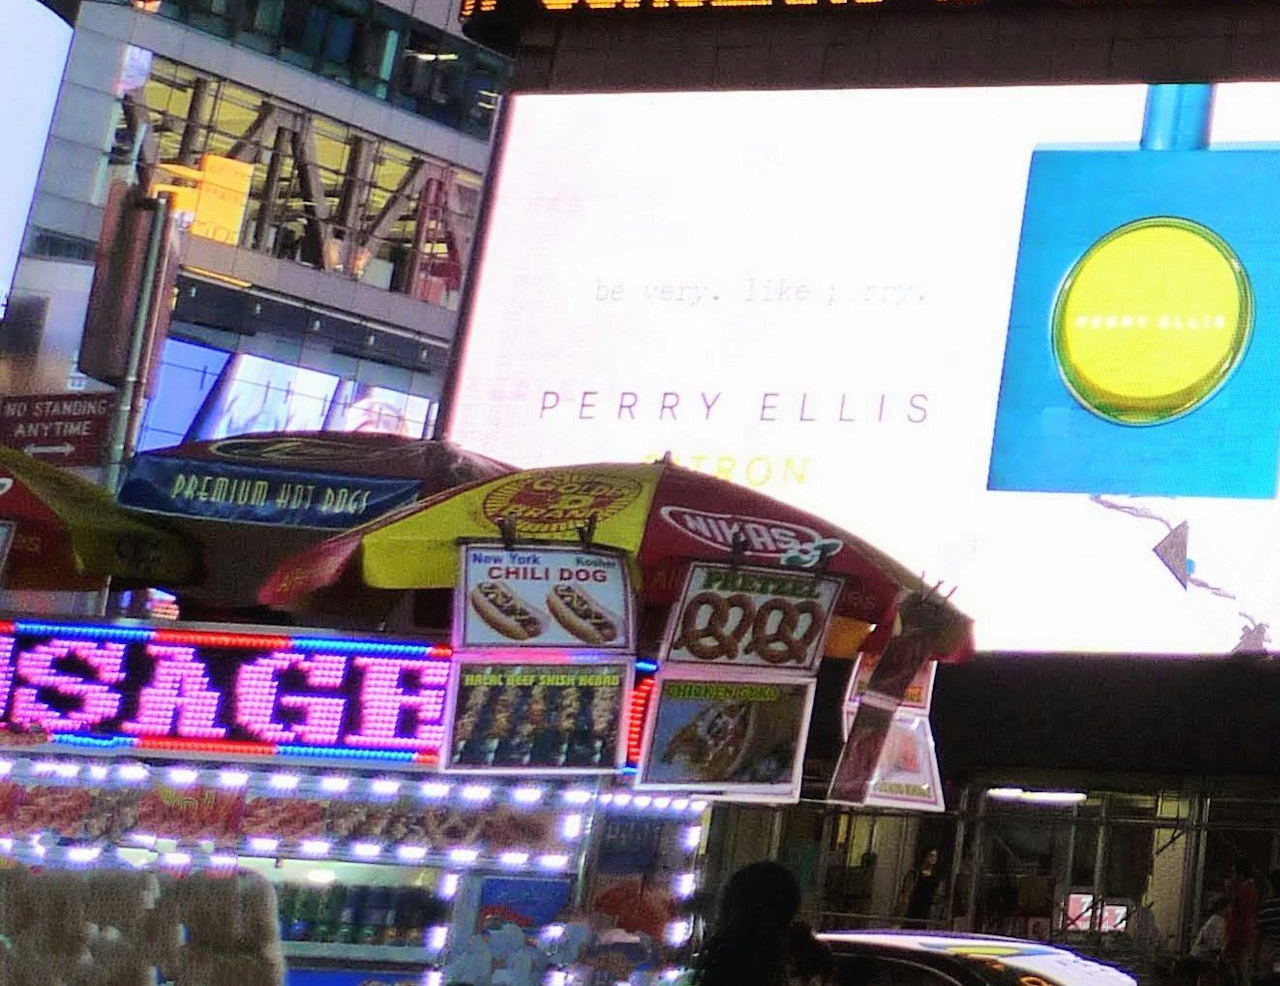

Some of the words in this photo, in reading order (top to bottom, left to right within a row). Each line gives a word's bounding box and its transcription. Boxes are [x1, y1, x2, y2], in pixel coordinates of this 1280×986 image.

[5, 401, 27, 417] NO
[33, 399, 107, 417] STANDING
[540, 391, 722, 420] PERRY
[760, 393, 929, 423] ELLIS
[14, 420, 92, 438] ANYTIME
[171, 473, 267, 507] PREMIUM
[277, 482, 313, 510] HOT
[322, 487, 370, 513] DOGS
[472, 553, 503, 564] New
[510, 553, 541, 565] York
[488, 566, 549, 580] CHILI
[559, 568, 608, 582] DOG
[704, 570, 821, 599] PRETZEL
[0, 636, 450, 750] SAGE
